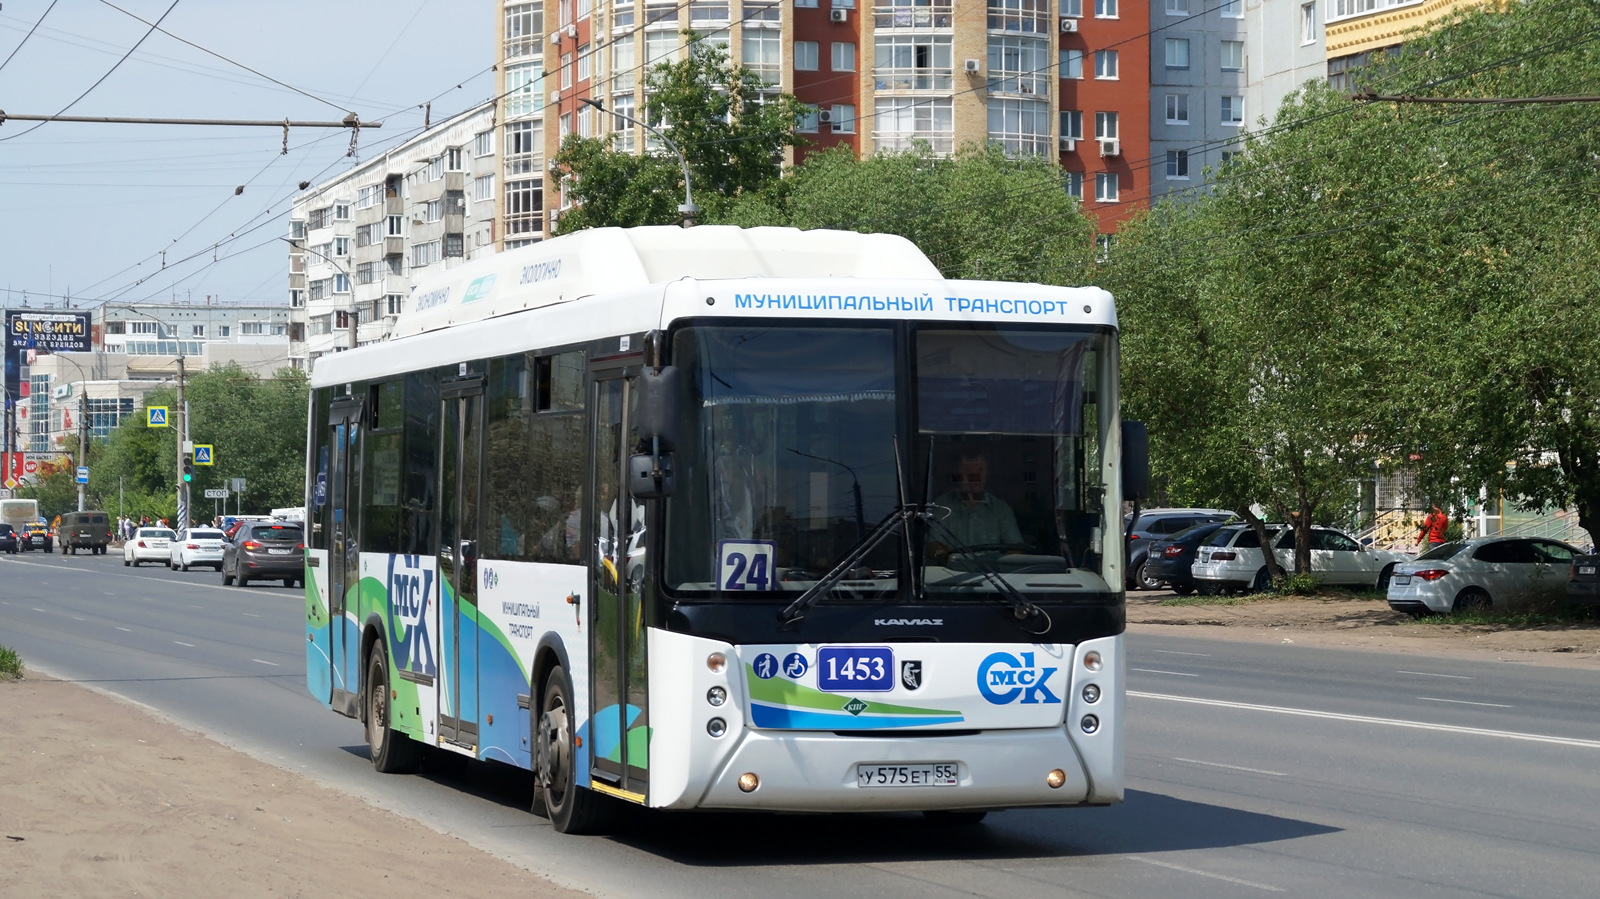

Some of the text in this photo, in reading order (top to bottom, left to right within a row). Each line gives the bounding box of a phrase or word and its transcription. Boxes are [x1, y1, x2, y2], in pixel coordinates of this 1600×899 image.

[519, 259, 562, 285] ЭКОЛОГИЧНО
[415, 286, 450, 312] ЭКОНОМИЧНО
[734, 293, 1068, 315] МУНИЦИПАЛЬНЫЙ ТРАНСПОРТ
[22, 333, 74, 341] СЗВЕЗДИЕ
[725, 552, 768, 590] 24
[502, 601, 540, 619] МУНИЦИПАЛЬНЫЙ
[508, 623, 533, 639] ТРАНСПОРТ
[874, 618, 944, 626] KAMAZ
[826, 656, 886, 682] 1453
[935, 765, 953, 778] 55
